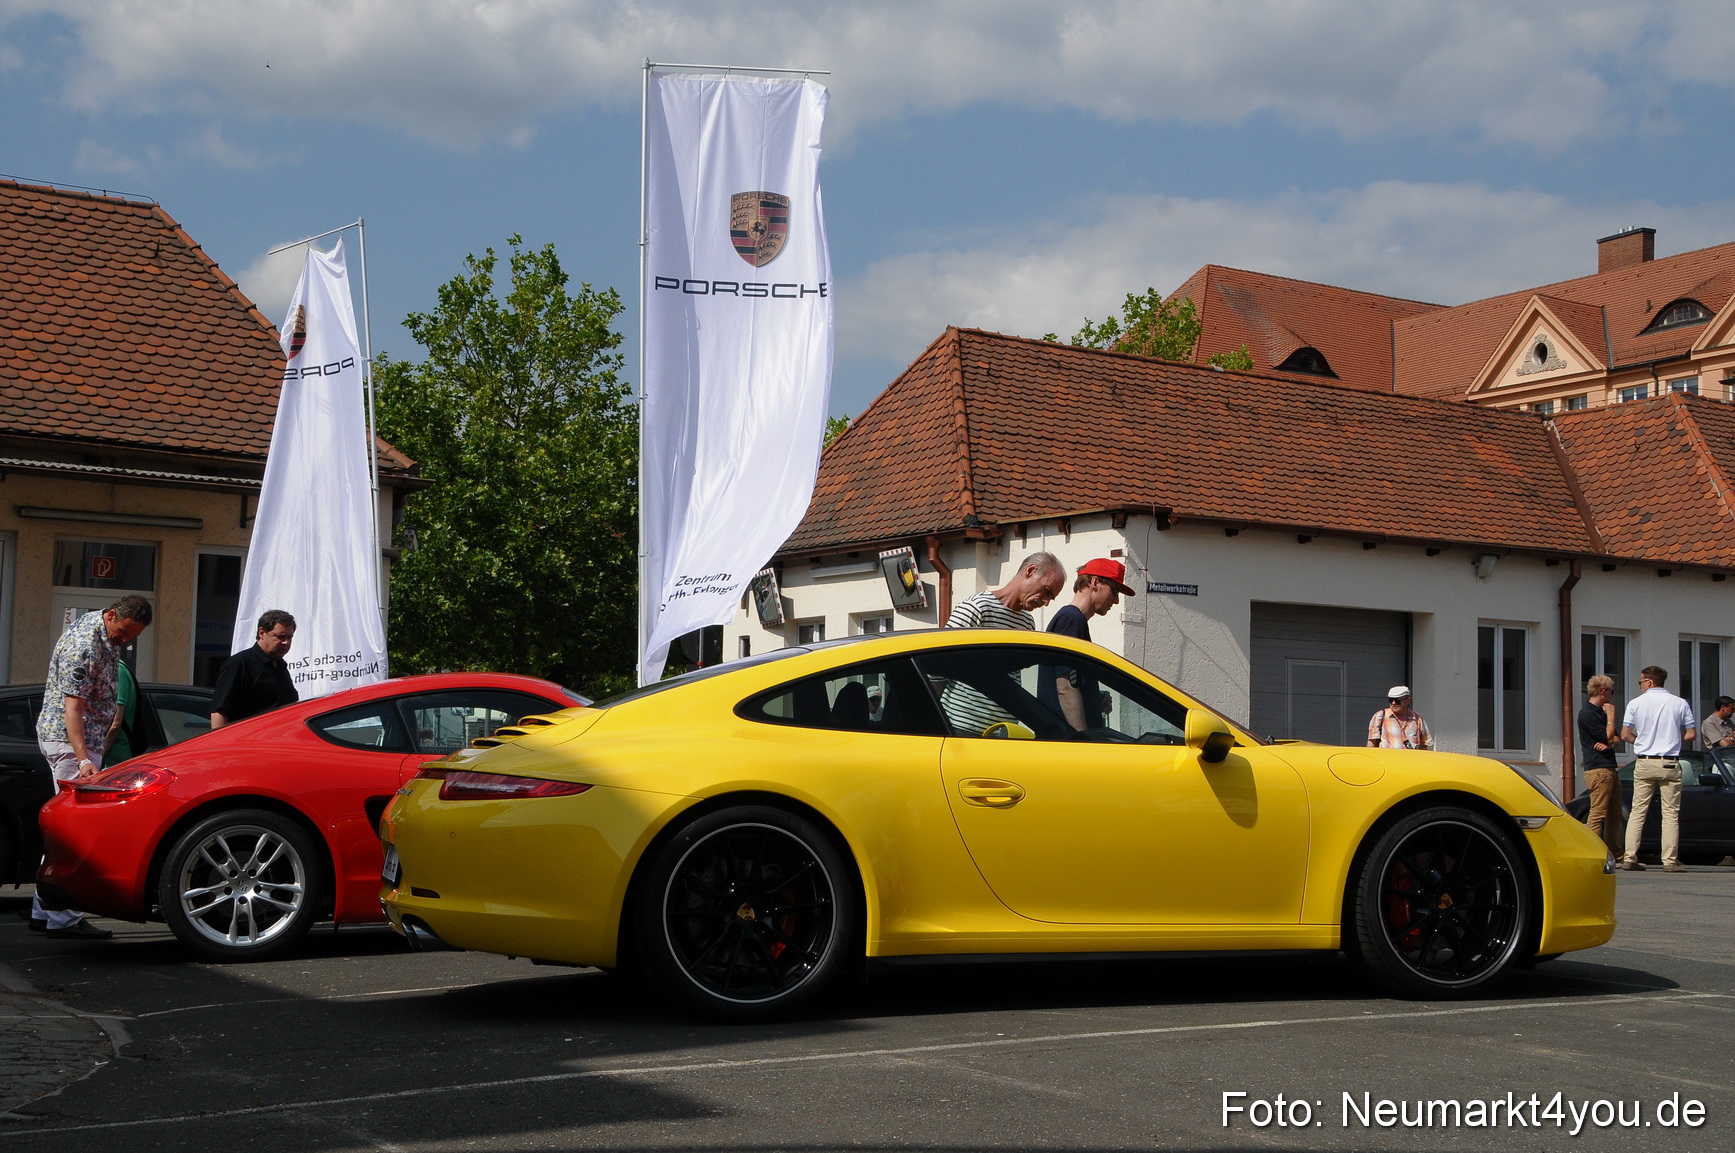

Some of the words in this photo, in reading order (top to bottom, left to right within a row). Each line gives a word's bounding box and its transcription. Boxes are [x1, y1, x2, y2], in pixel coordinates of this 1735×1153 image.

[731, 192, 788, 204] PORSCHE
[655, 276, 828, 299] PORSCHE
[674, 573, 732, 587] Zentrum
[1149, 583, 1197, 595] Metallwerkstraße
